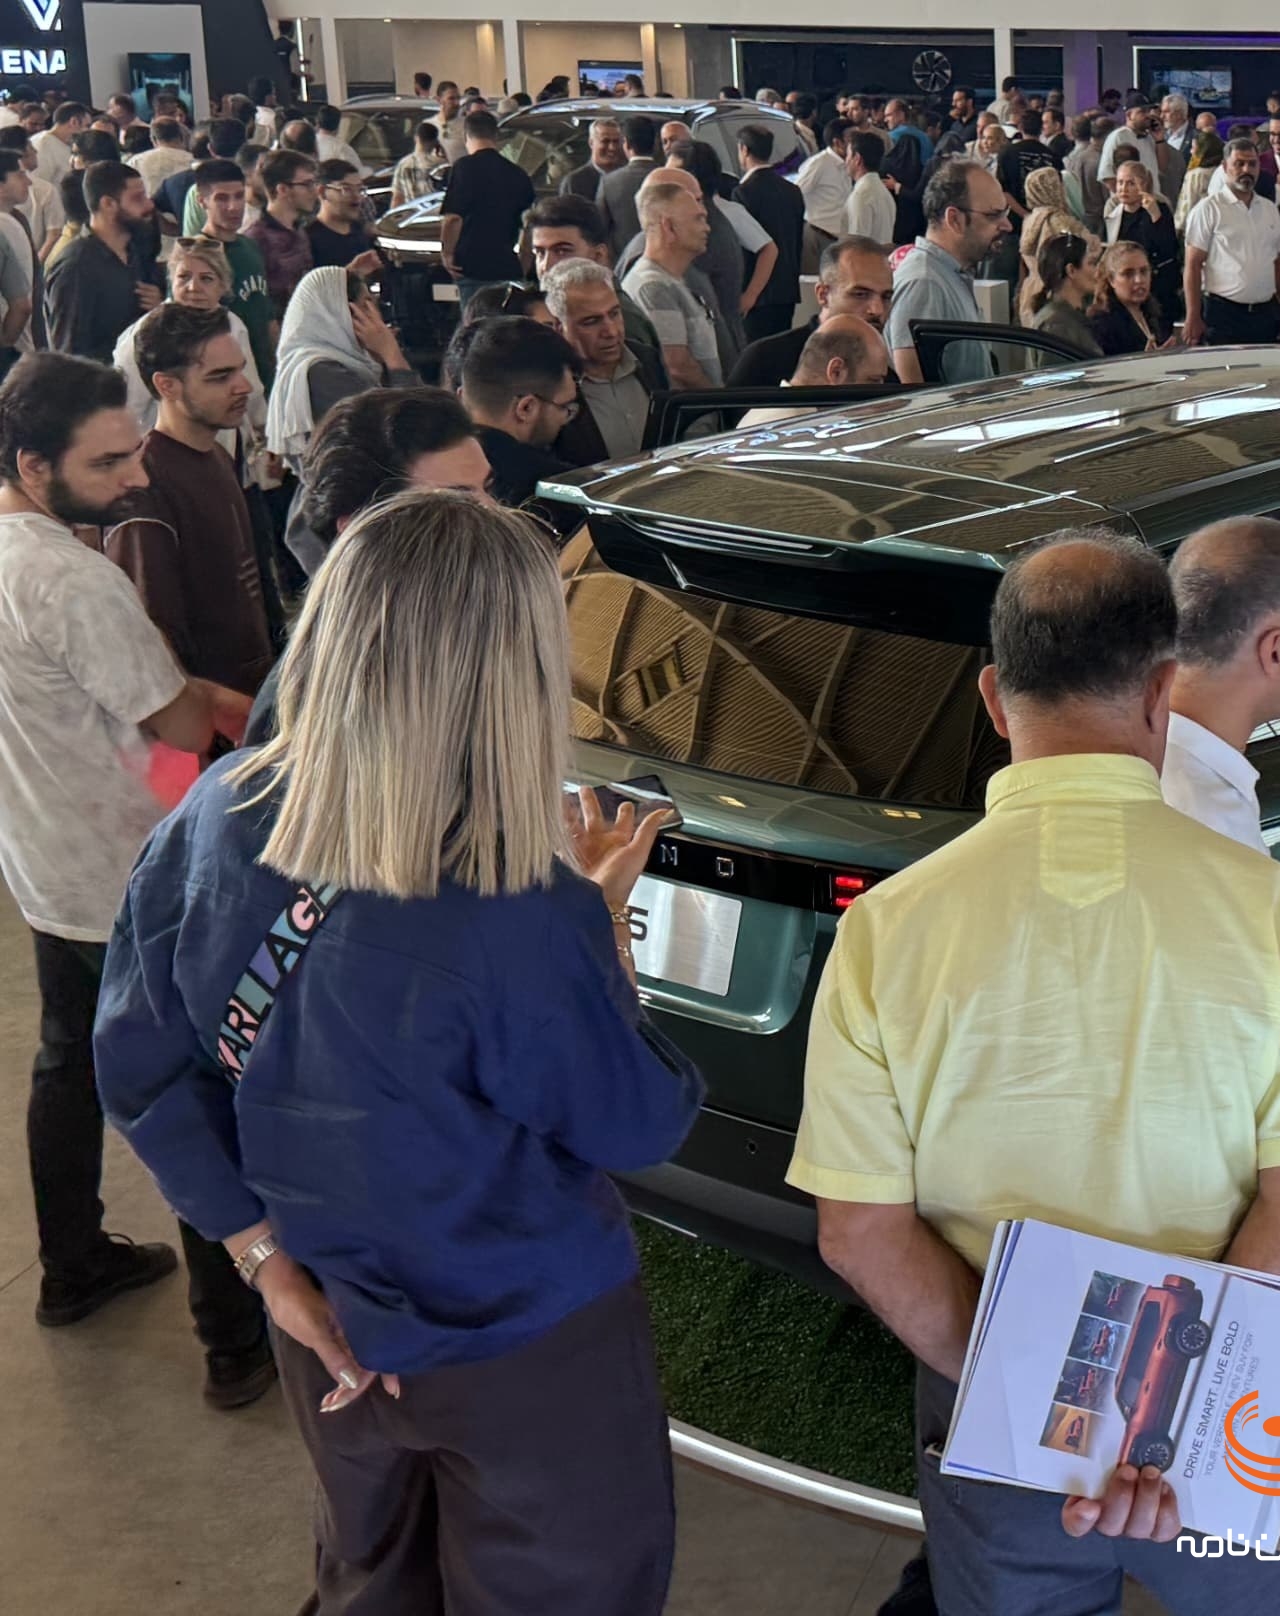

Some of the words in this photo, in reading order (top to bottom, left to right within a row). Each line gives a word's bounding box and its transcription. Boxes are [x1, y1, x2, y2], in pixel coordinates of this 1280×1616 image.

[0, 49, 67, 75] ENA
[1182, 1438, 1204, 1479] DRIVE
[1210, 1357, 1228, 1385] LIVE
[1219, 1319, 1240, 1356] BOLD
